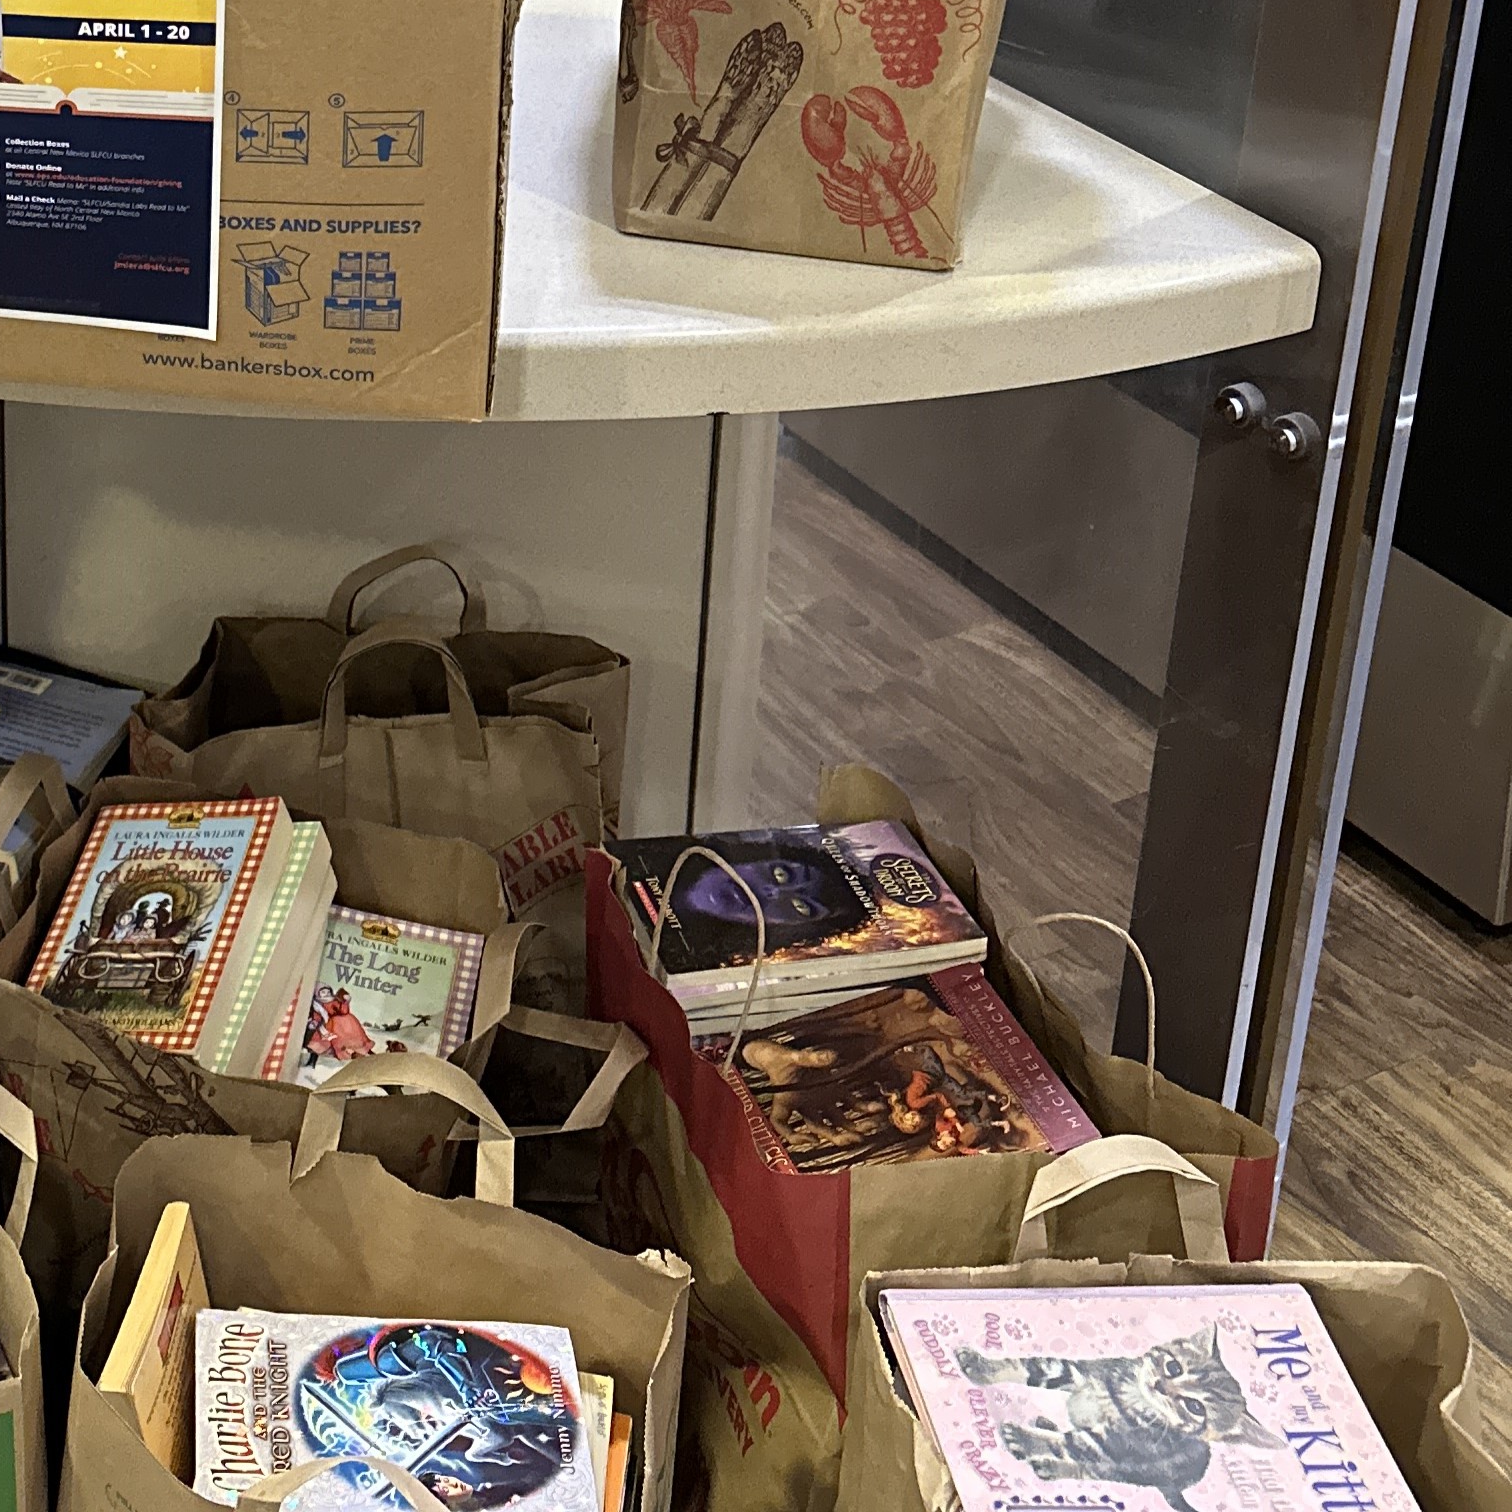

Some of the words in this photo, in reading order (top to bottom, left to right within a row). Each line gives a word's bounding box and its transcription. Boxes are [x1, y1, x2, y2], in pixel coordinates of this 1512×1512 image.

[78, 22, 135, 38] APRIL
[140, 24, 150, 38] 1
[166, 25, 190, 39] 20
[220, 216, 276, 232] BOXES
[280, 218, 322, 232] AND
[326, 220, 422, 234] SUPPLIES?
[348, 346, 376, 355] BOXES
[349, 337, 376, 346] PRIME
[142, 352, 375, 382] www.bankersbox.com
[110, 840, 166, 862] Little
[168, 840, 234, 860] House
[114, 830, 151, 840] LAURA
[152, 830, 202, 839] INGALLS
[203, 829, 246, 838] WILDER
[96, 869, 124, 884] on
[124, 865, 162, 884] the
[162, 862, 232, 884] Prairie
[880, 858, 936, 904] SECRETS
[326, 941, 364, 966] The
[367, 950, 422, 984] Long
[348, 936, 400, 954] INGALLS
[402, 949, 448, 966] WILDER
[335, 964, 402, 996] Winter
[962, 974, 1020, 1046] BUCKLEY
[1022, 1053, 1082, 1129] MICHAEL
[913, 1319, 962, 1380] CUDDLY
[985, 1312, 1003, 1350] COOL
[208, 1323, 264, 1384] Bone
[1250, 1324, 1313, 1380] Me
[252, 1366, 266, 1400] THE
[268, 1340, 290, 1421] KNIGHT
[549, 1366, 566, 1420] Nimmo
[1302, 1385, 1330, 1412] and
[253, 1404, 268, 1440] AND
[968, 1389, 998, 1450] CLEVER
[1292, 1404, 1314, 1424] my
[208, 1391, 266, 1492] Charlie
[272, 1426, 292, 1475] RED
[557, 1424, 576, 1475] Jenny
[960, 1440, 1012, 1491] CRAZY
